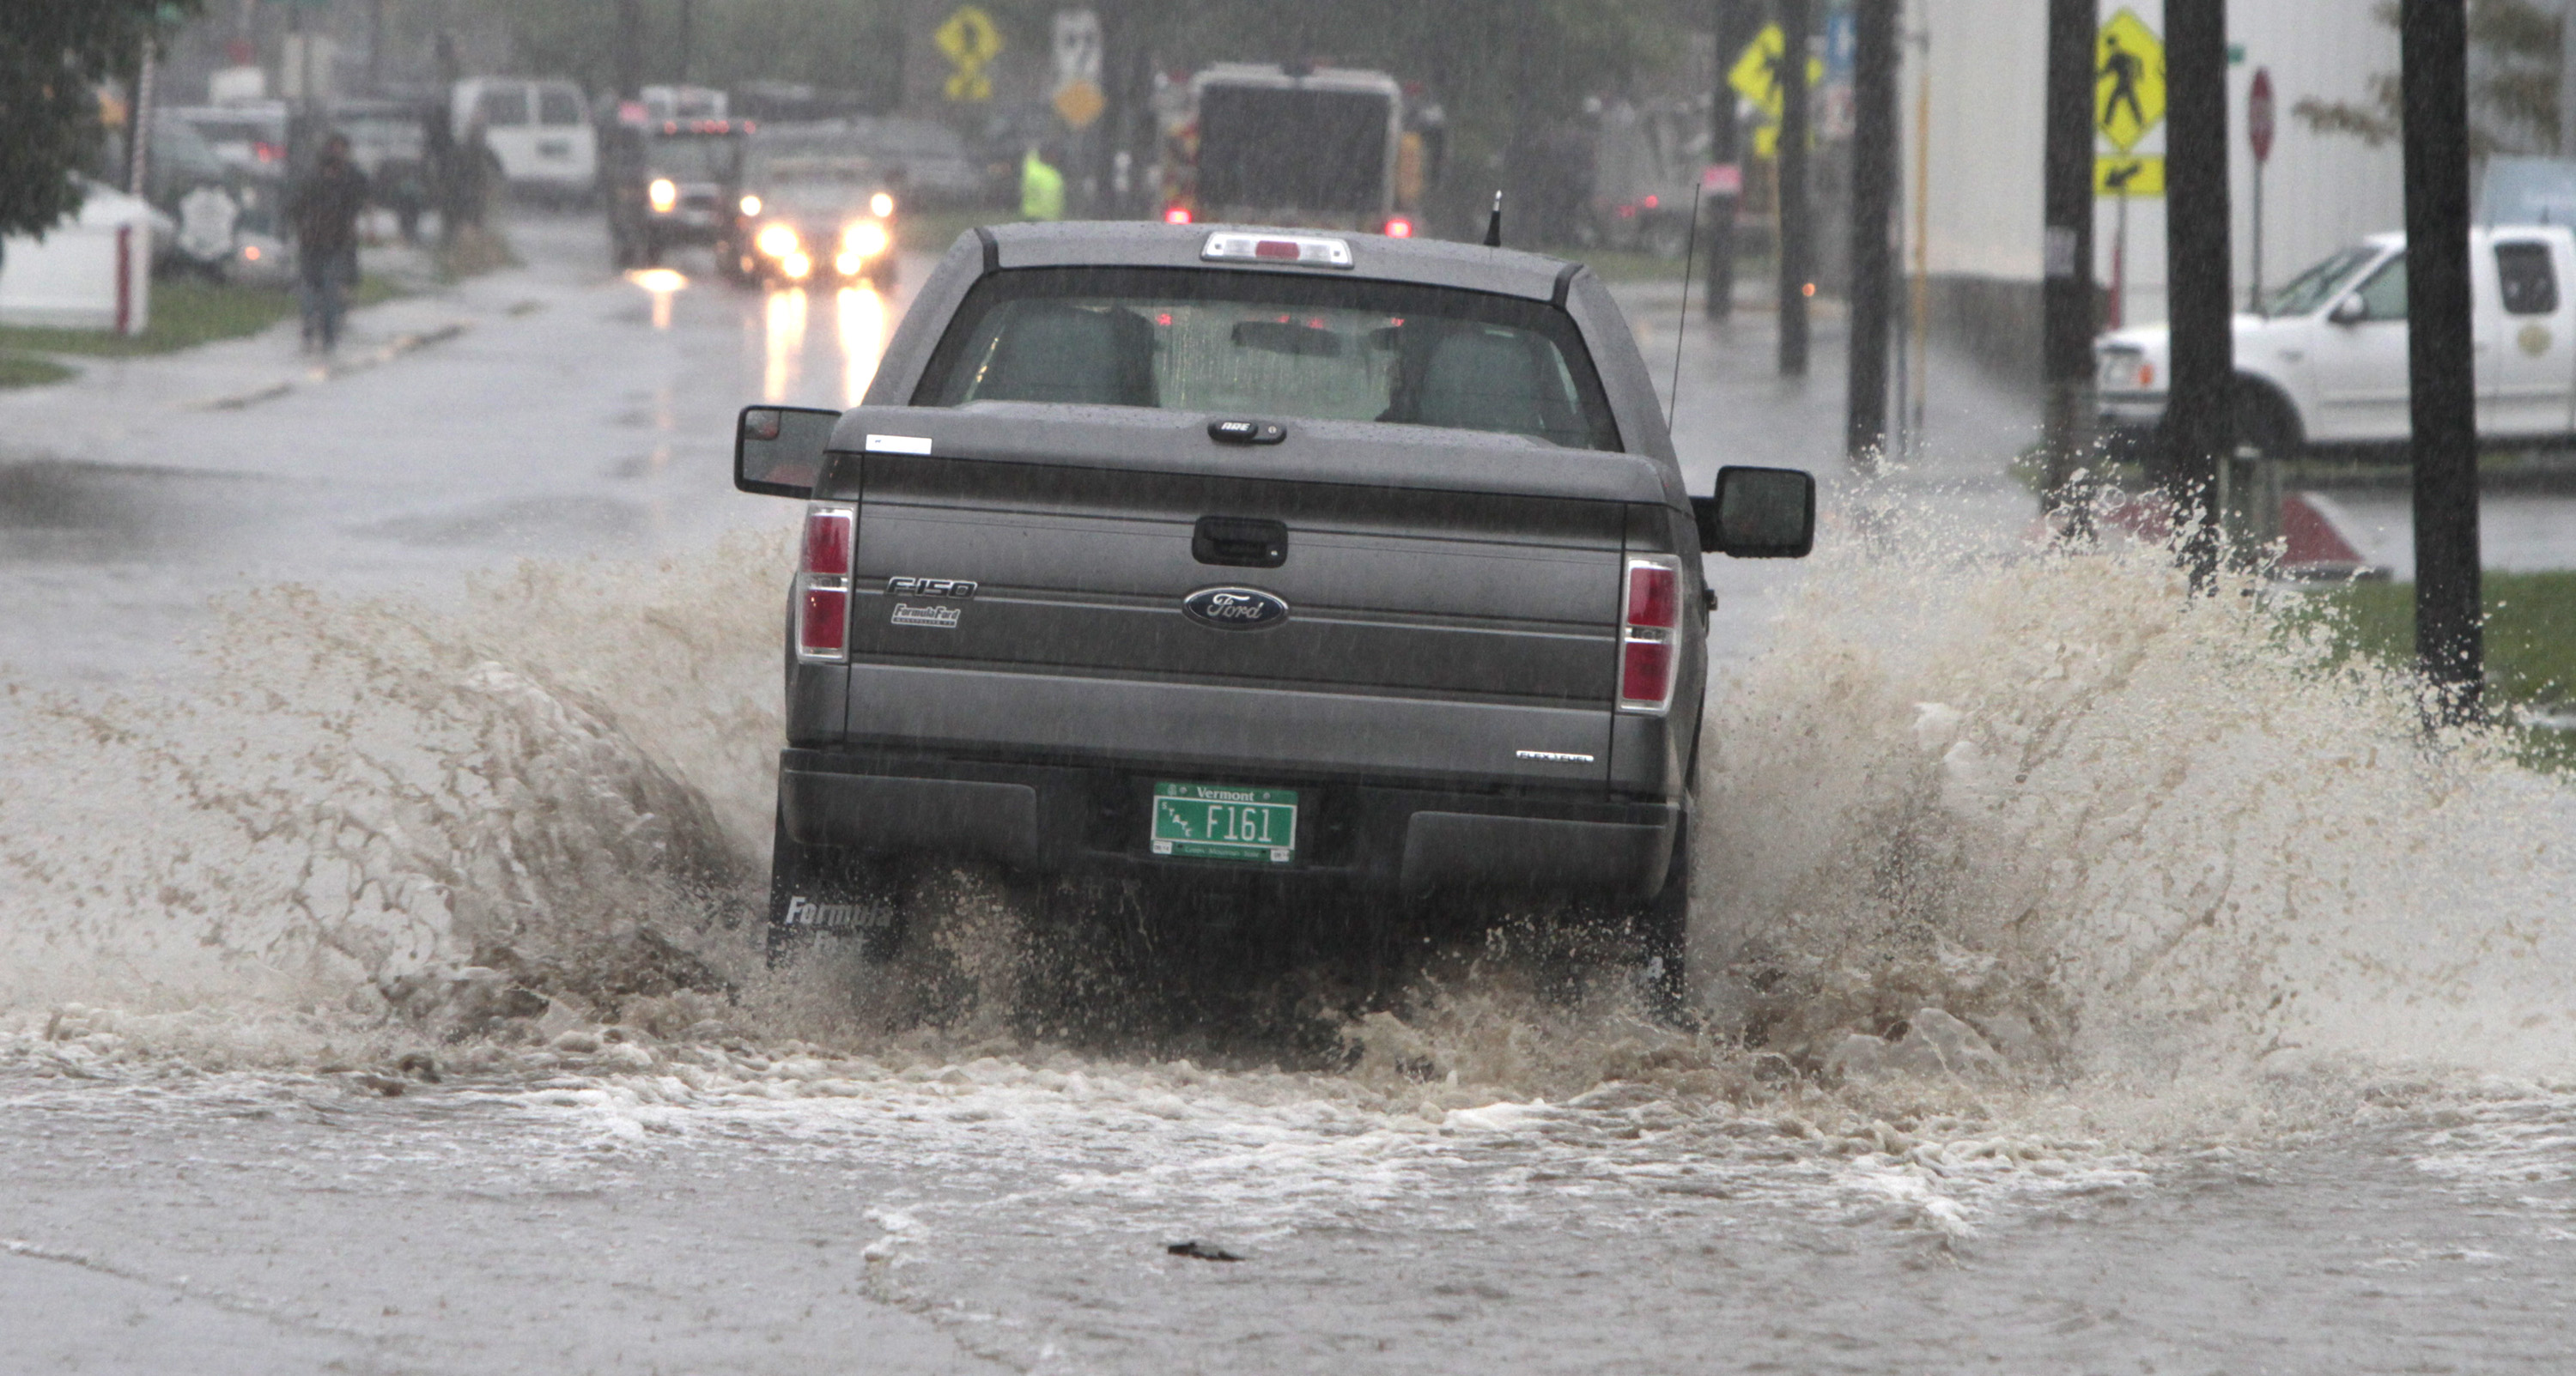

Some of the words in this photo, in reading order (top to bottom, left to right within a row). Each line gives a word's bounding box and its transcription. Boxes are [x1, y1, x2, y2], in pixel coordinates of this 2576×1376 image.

[1221, 421, 1251, 432] ARE
[1206, 593, 1264, 619] Ford
[1197, 786, 1255, 802] Vermont
[1206, 804, 1273, 842] F161
[785, 895, 894, 927] Formula
